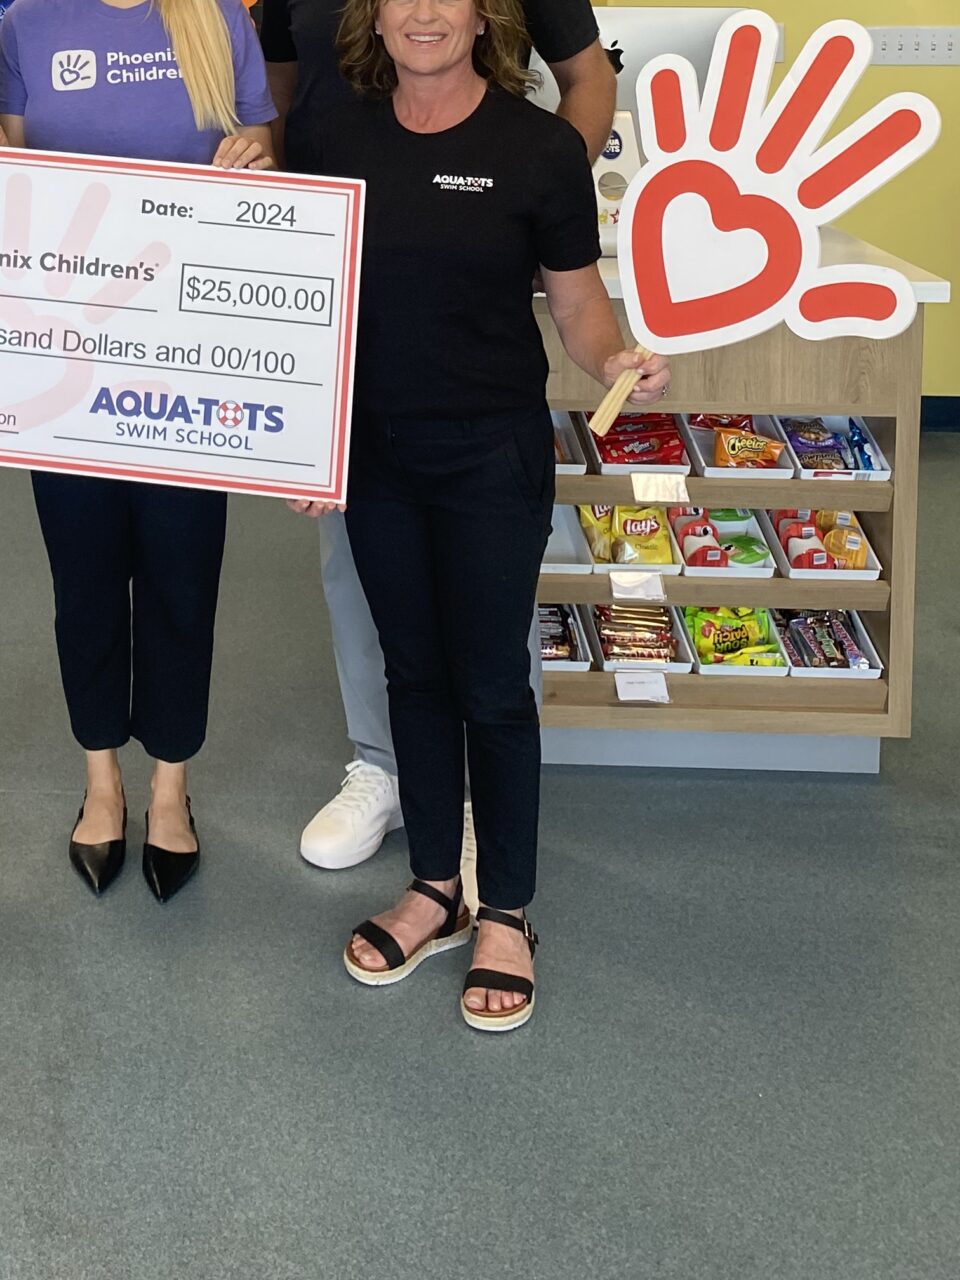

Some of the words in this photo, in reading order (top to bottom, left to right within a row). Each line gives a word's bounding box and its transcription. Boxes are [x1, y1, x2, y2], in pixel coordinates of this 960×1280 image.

[432, 174, 494, 187] AQUA-TOTS
[141, 199, 193, 218] Date:
[235, 201, 297, 227] 2024
[39, 251, 156, 282] Children's
[186, 276, 326, 312] $25,000.00
[62, 329, 146, 360] Dollars
[155, 344, 201, 365] and
[211, 345, 296, 375] 00/100
[89, 386, 284, 433] AQUA-TOTS
[115, 421, 167, 441] SWIM
[175, 428, 254, 451] SCHOOL
[626, 516, 659, 536] Lay's
[714, 624, 749, 644] PATCH
